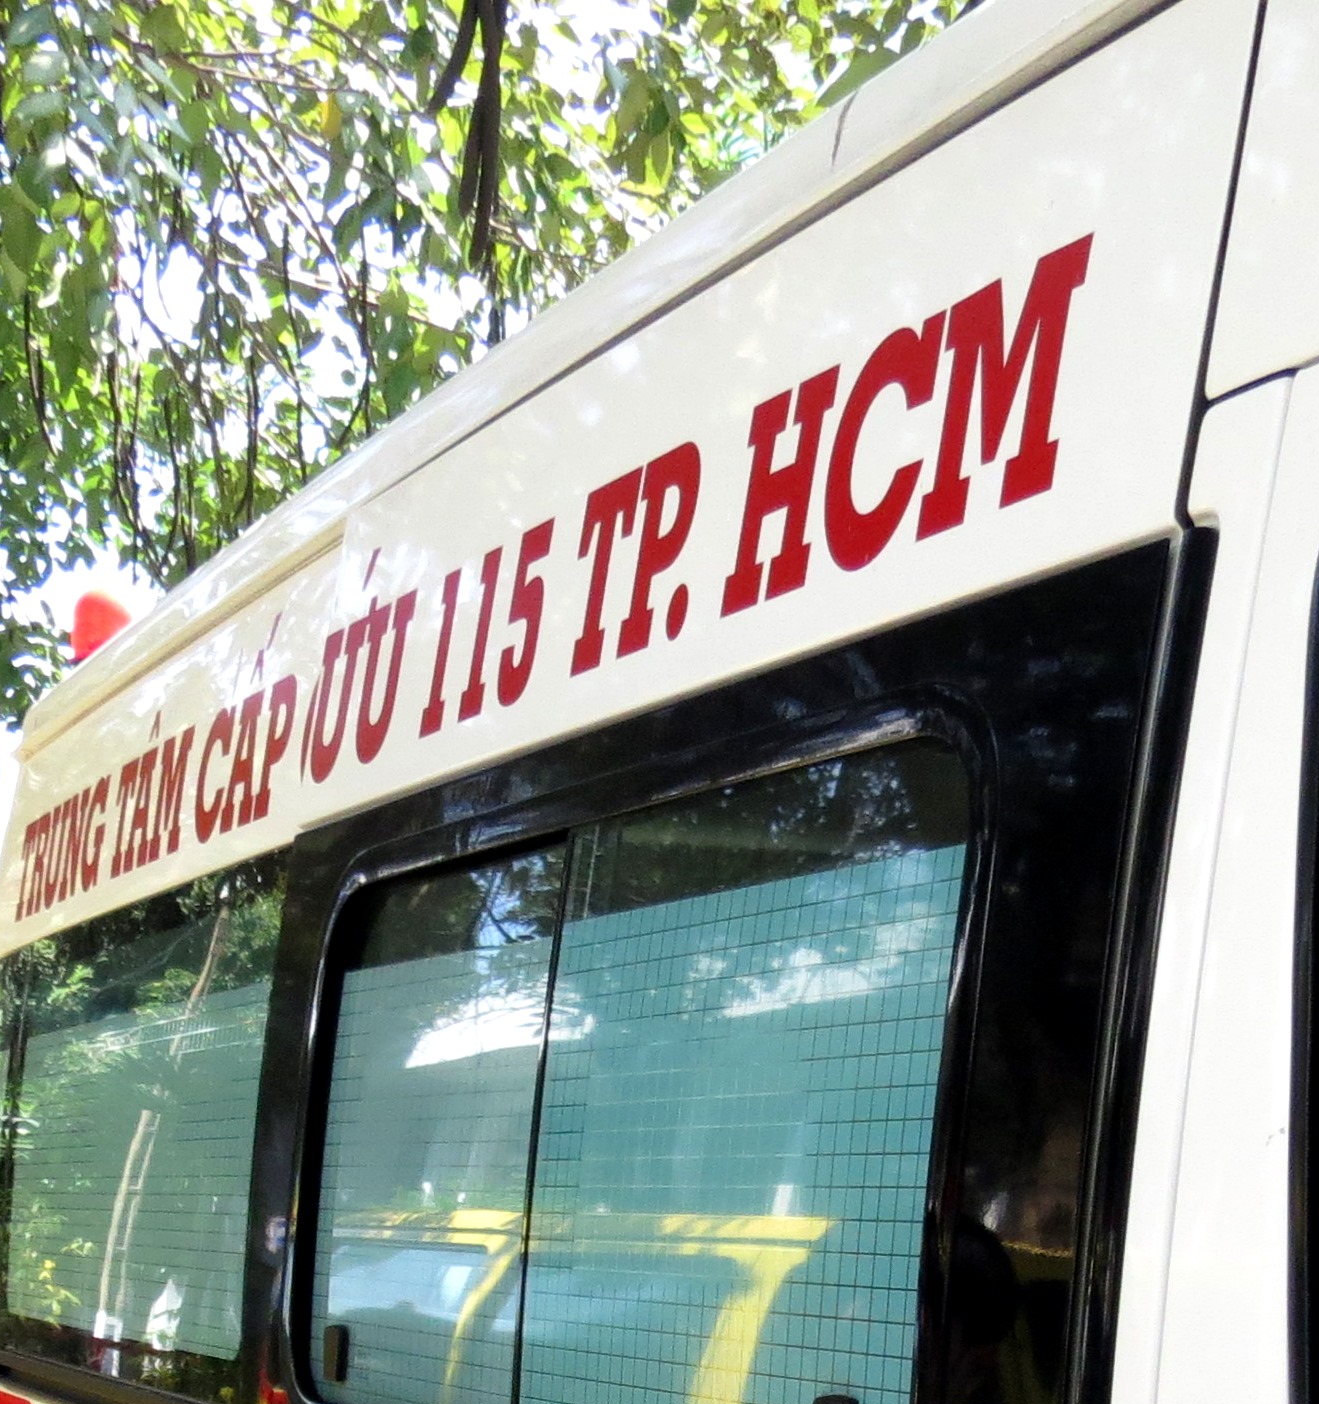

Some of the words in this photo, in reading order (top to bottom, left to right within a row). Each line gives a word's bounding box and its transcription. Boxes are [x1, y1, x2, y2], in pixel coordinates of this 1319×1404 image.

[14, 774, 112, 922] TRUNG
[110, 709, 196, 880] TÂM
[194, 611, 298, 845] CẤP
[300, 547, 418, 784] ỨU
[418, 517, 555, 739] 115
[570, 440, 702, 678] TP.
[720, 231, 1094, 619] HCM
